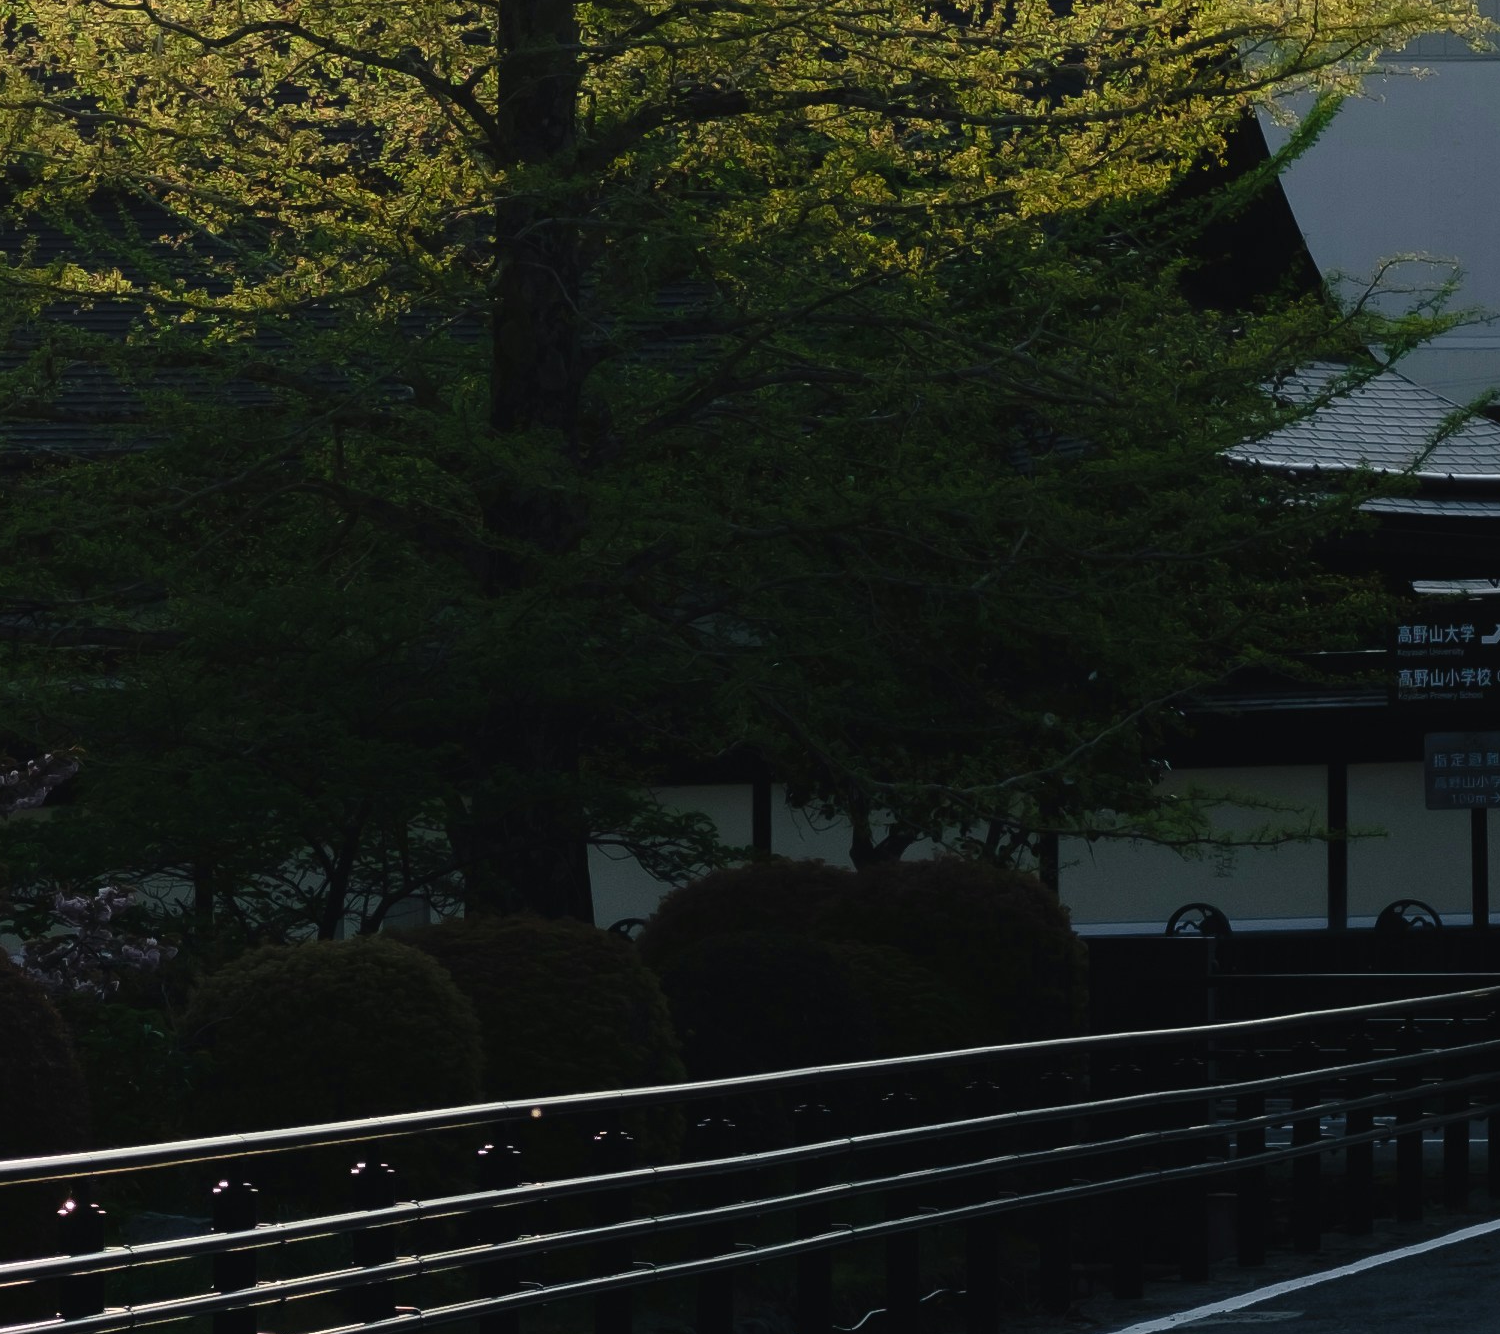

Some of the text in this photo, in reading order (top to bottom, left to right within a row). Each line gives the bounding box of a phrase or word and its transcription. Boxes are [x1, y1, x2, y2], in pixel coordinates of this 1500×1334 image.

[1397, 623, 1475, 645] 高野山大学
[1398, 667, 1492, 688] 高野山小学校
